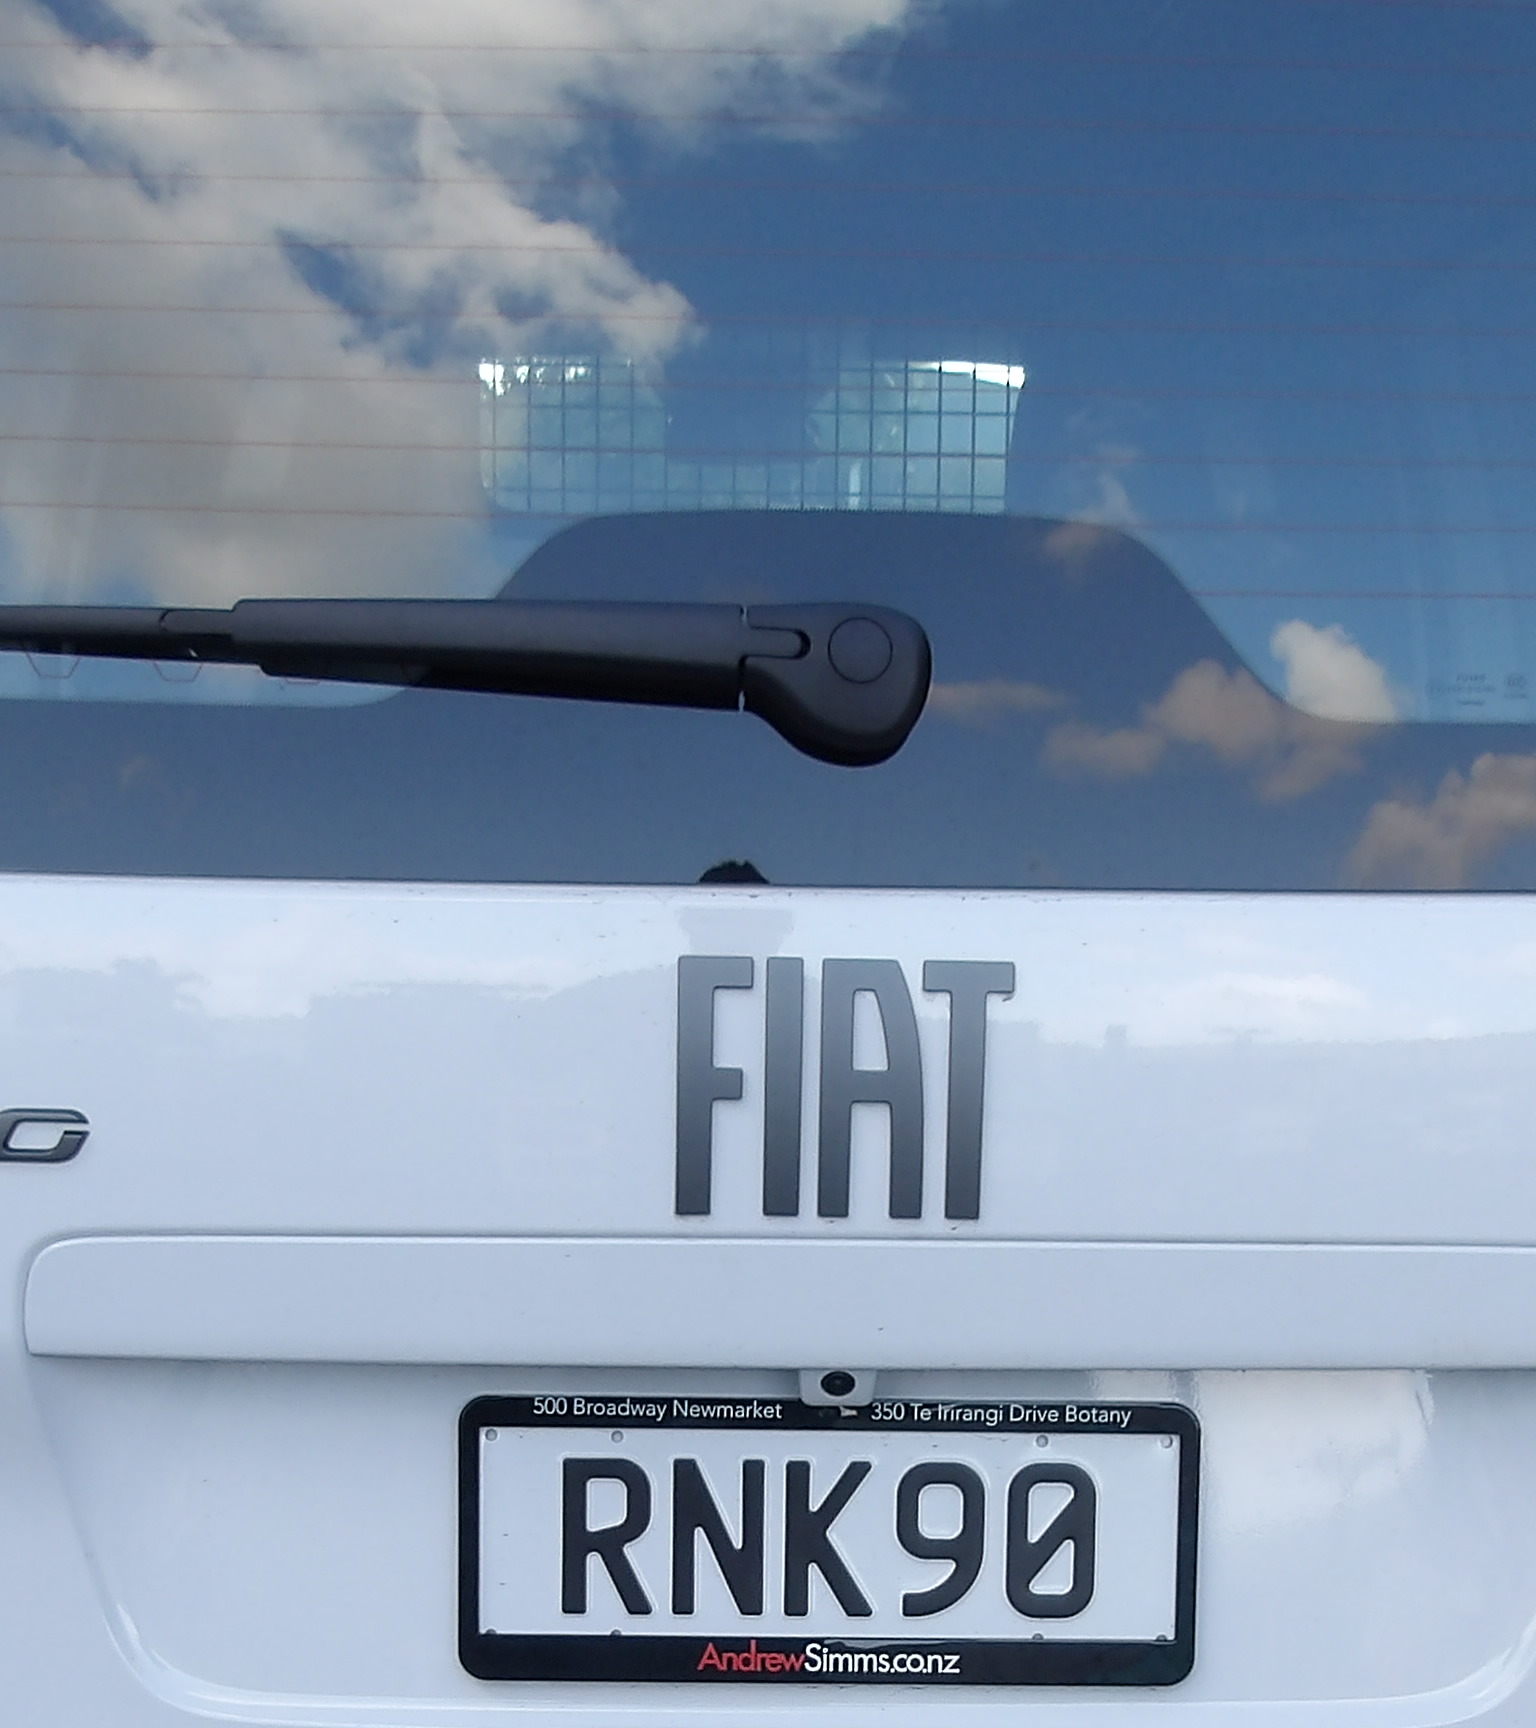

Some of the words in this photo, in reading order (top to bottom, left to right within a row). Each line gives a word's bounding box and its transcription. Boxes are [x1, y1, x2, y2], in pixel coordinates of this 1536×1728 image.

[675, 955, 1016, 1220] FIAT
[532, 1396, 568, 1416] 500
[573, 1398, 667, 1422] Broadway
[672, 1399, 784, 1420] Newmarket
[870, 1402, 906, 1421] 350
[910, 1403, 933, 1421] Te
[937, 1403, 1004, 1427] Irirangi
[1009, 1404, 1060, 1423] Drive
[1065, 1405, 1133, 1428] Botany
[561, 1457, 1098, 1619] RNK90
[697, 1639, 962, 1674] AndrewSimms.co.nz
